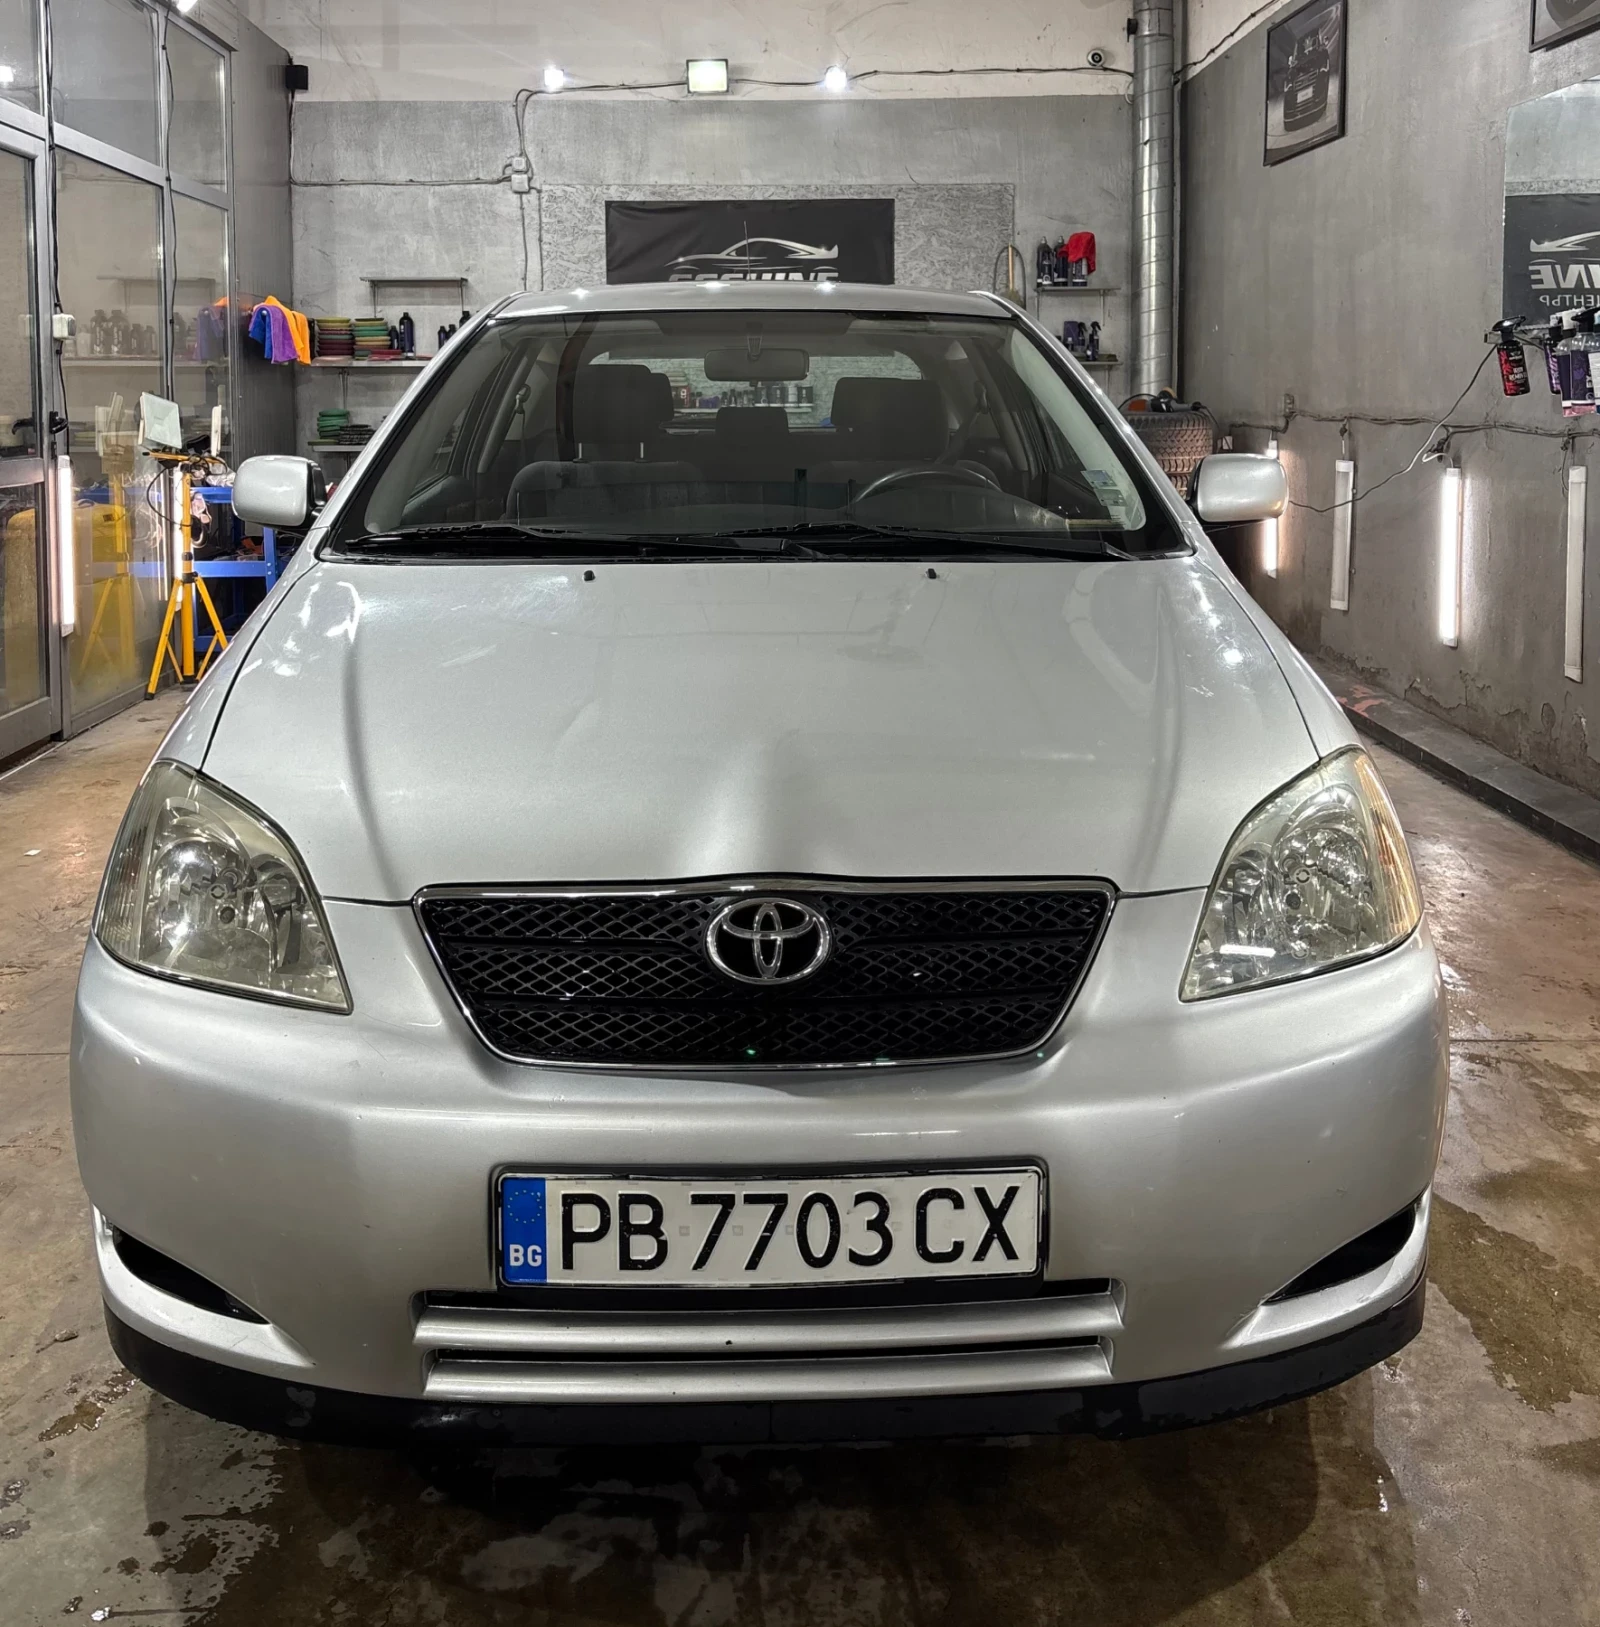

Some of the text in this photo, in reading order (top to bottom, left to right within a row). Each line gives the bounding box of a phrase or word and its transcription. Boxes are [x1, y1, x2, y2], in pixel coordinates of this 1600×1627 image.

[509, 1243, 543, 1267] BG
[561, 1185, 1021, 1271] PB 7703 CX
